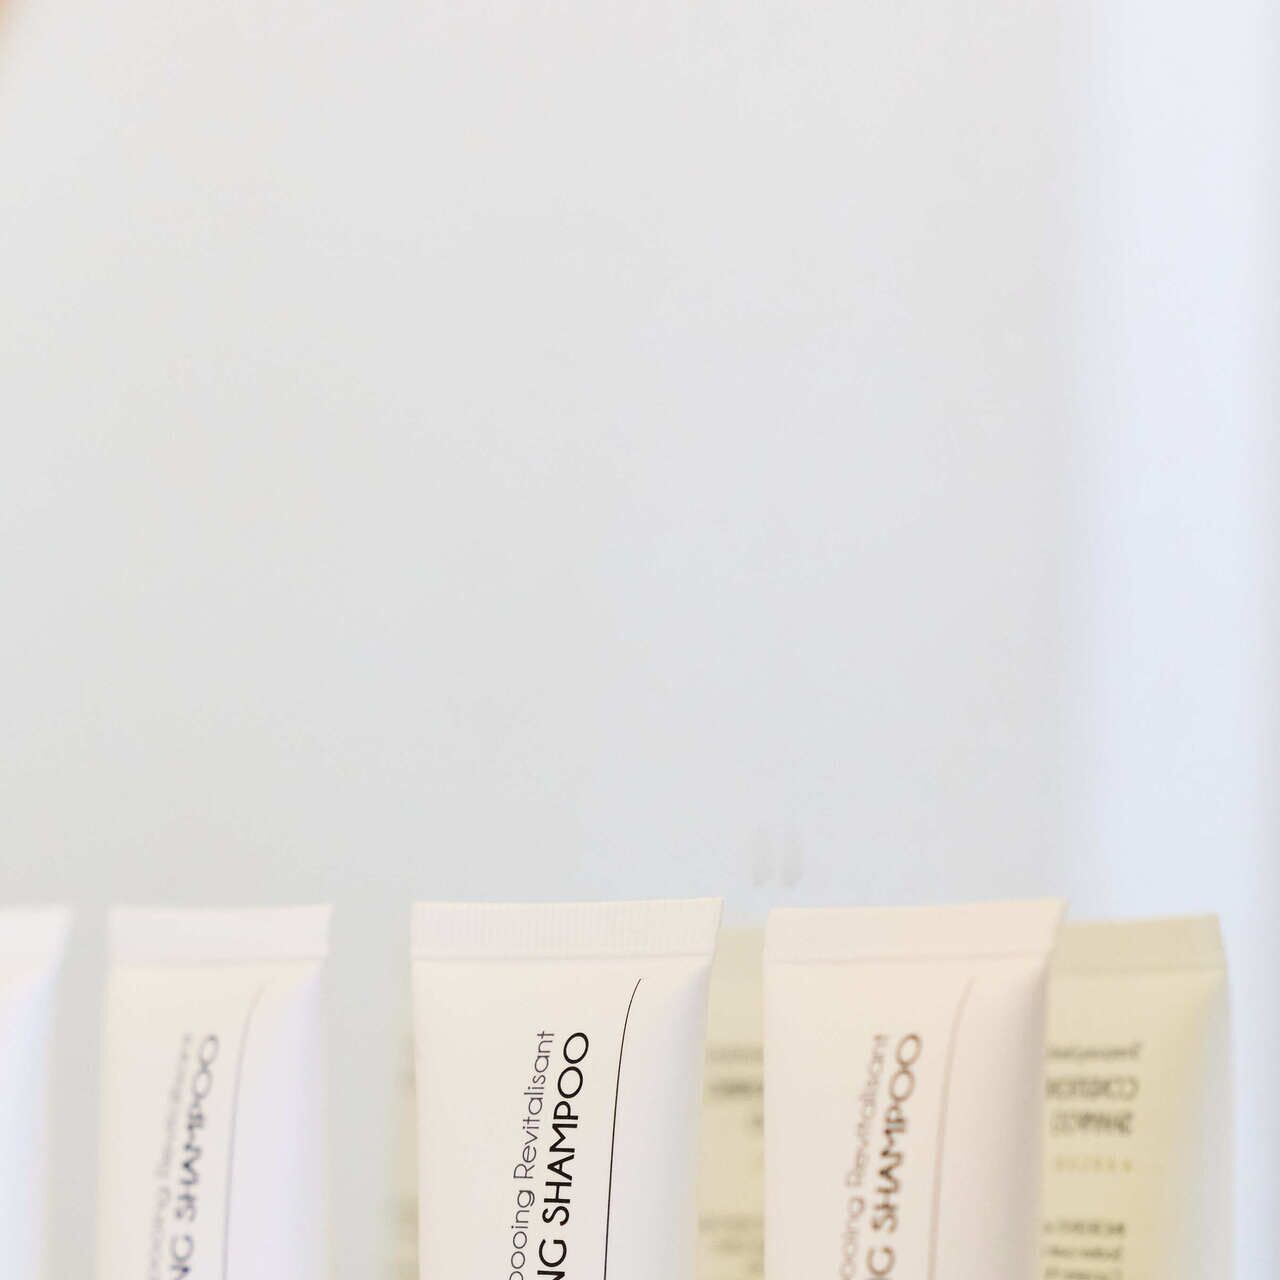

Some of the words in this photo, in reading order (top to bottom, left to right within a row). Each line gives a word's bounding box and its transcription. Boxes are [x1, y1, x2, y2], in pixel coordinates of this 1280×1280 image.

[175, 1034, 219, 1223] SHAMPOO
[513, 1030, 555, 1180] Revitalisant
[542, 1032, 590, 1227] SHAMPOO
[844, 1034, 888, 1187] Revitalisant
[871, 1033, 922, 1233] SHAMPOO
